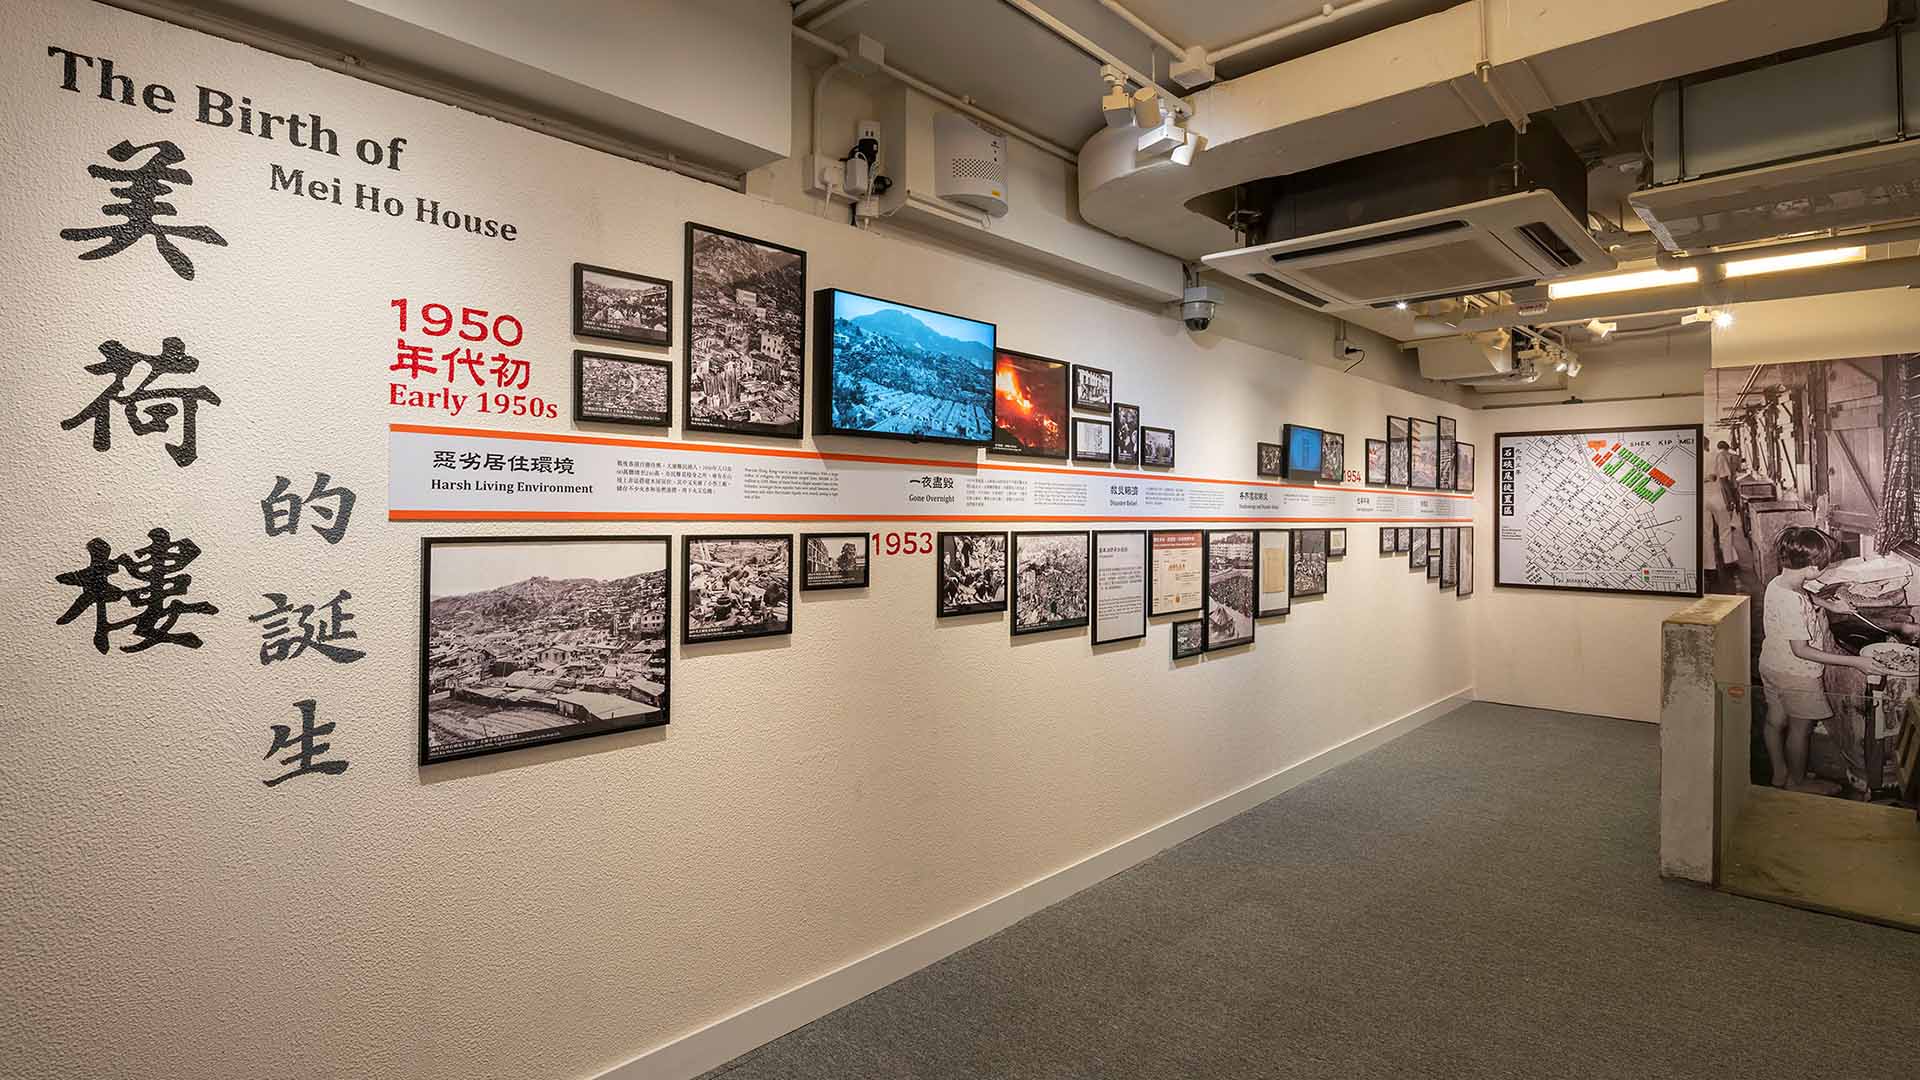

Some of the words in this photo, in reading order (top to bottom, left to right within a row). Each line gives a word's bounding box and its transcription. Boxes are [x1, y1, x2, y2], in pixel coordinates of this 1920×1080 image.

[48, 46, 176, 113] The
[196, 85, 339, 156] Birth
[356, 137, 407, 171] of
[270, 163, 342, 205] Mei
[355, 183, 403, 217] Ho
[416, 198, 518, 241] House
[390, 297, 524, 348] 1950
[389, 338, 531, 390] 年代初
[55, 139, 228, 655] 美荷樓
[389, 383, 468, 416] Early
[477, 391, 558, 419] 1950s
[1679, 437, 1695, 445] MEI
[433, 451, 575, 475] 惡劣居住環境
[1344, 470, 1361, 482] 1954
[431, 479, 471, 491] Harsh
[475, 481, 514, 494] Living
[517, 482, 593, 494] Environment
[909, 476, 954, 489] 一夜盡毀
[909, 494, 925, 502] Gone
[926, 495, 954, 504] Overnight
[872, 531, 933, 556] 1953
[249, 472, 367, 787] 的誕生
